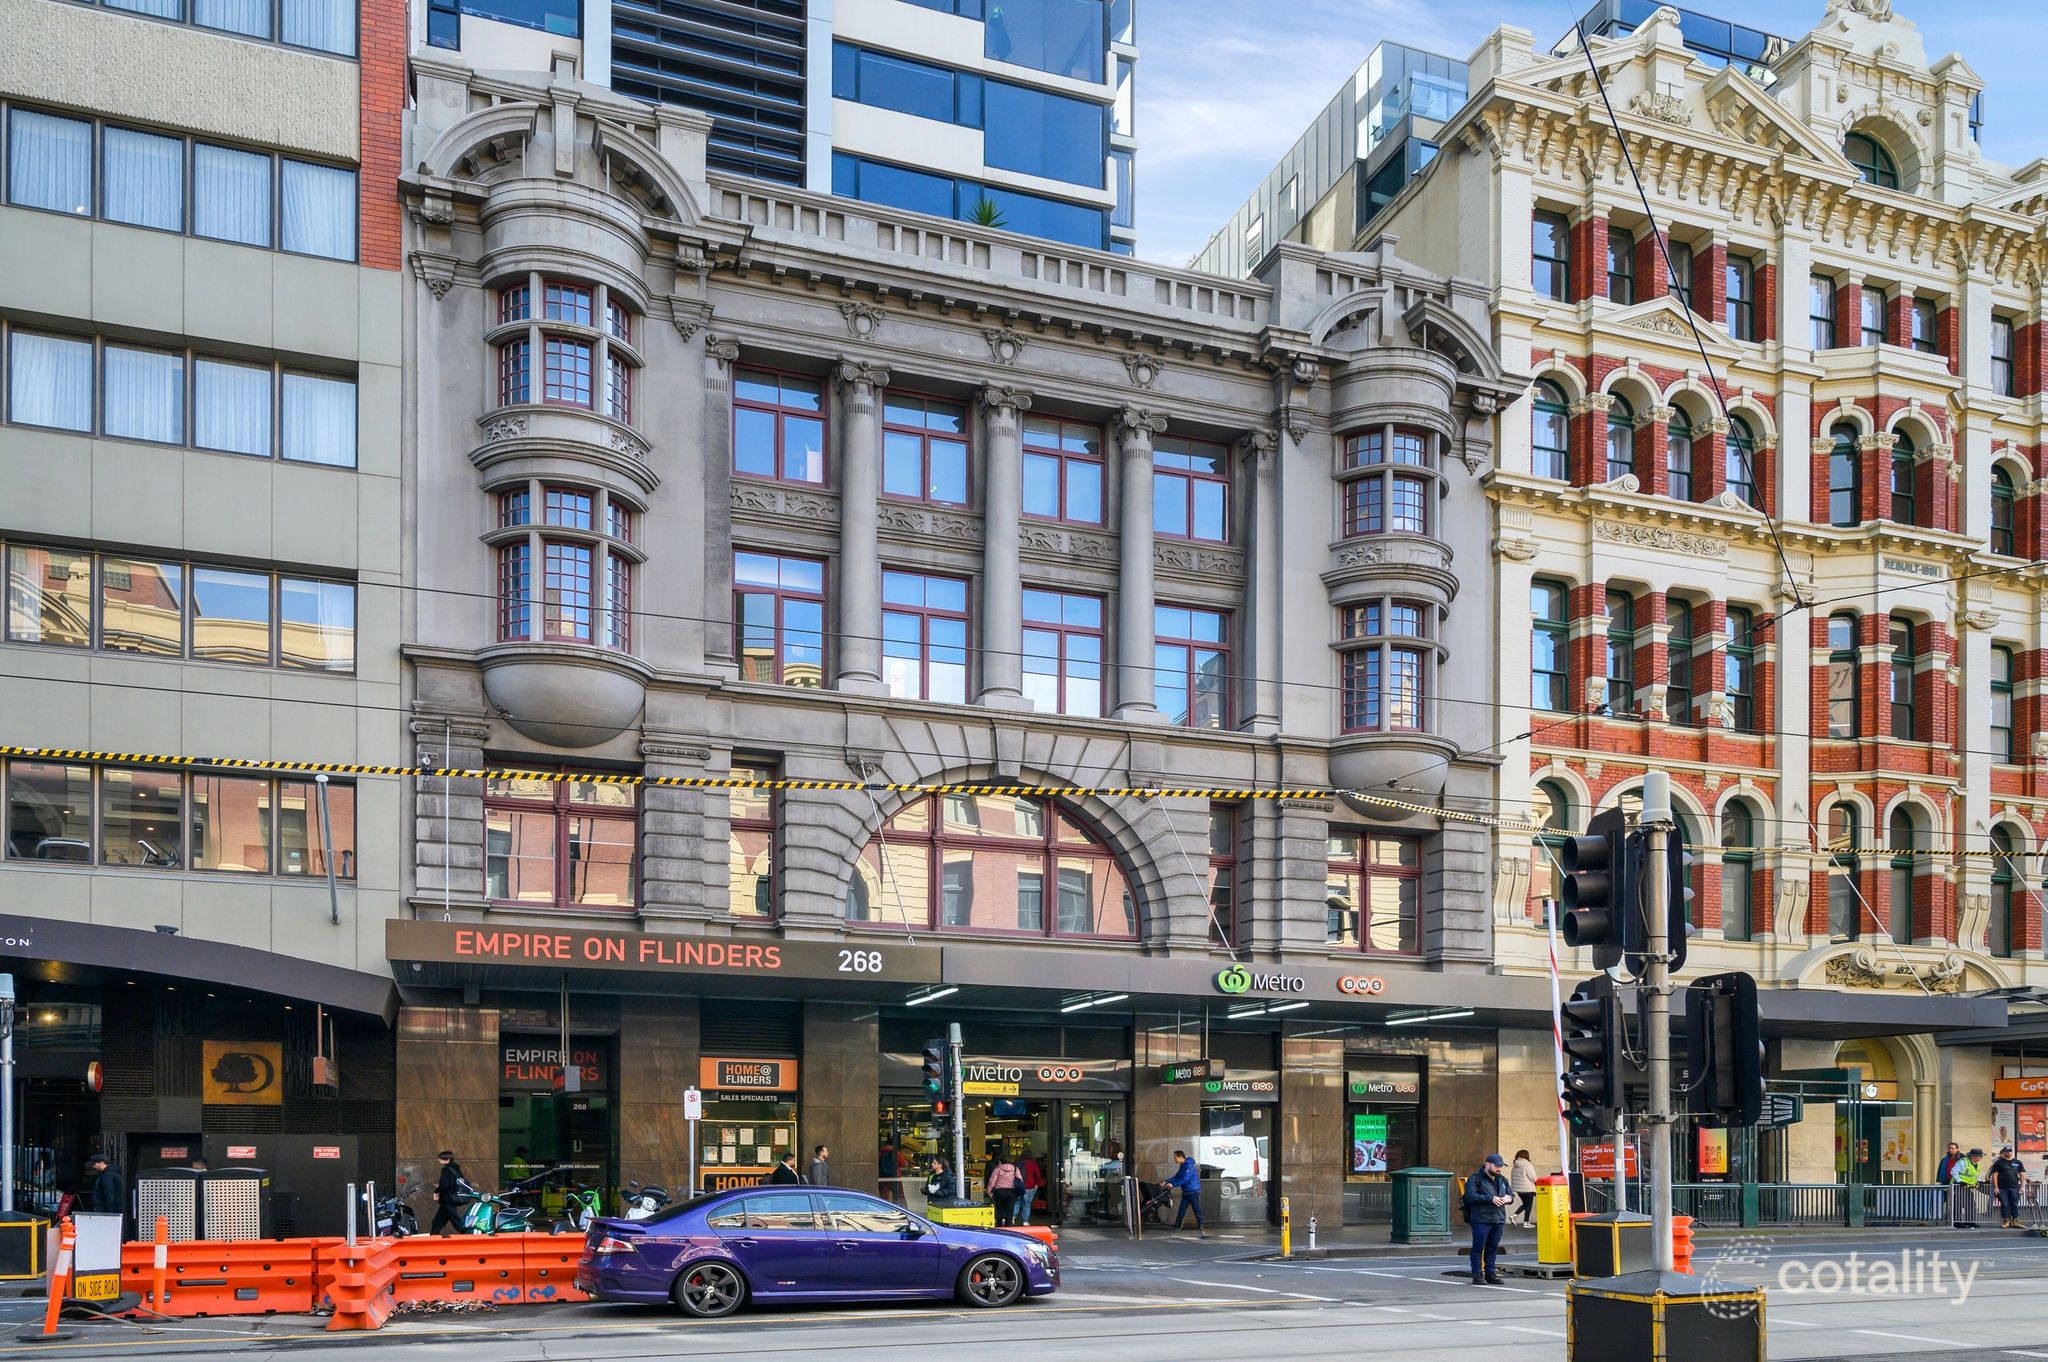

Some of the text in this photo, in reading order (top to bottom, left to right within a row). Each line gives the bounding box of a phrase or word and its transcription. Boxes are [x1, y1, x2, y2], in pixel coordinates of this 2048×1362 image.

[455, 930, 781, 969] EMPIRE ON FLINDERS
[837, 949, 883, 973] 268
[1253, 973, 1305, 992] Metro
[573, 1051, 597, 1064] ON
[725, 1064, 772, 1076] HOME@
[969, 1064, 1023, 1082] Metro
[1042, 1068, 1079, 1080] BWS
[725, 1075, 772, 1085] FLINDERS
[1222, 1081, 1249, 1091] Metro
[1368, 1083, 1393, 1093] Metro
[77, 1279, 118, 1298] ON SIDE ROAD
